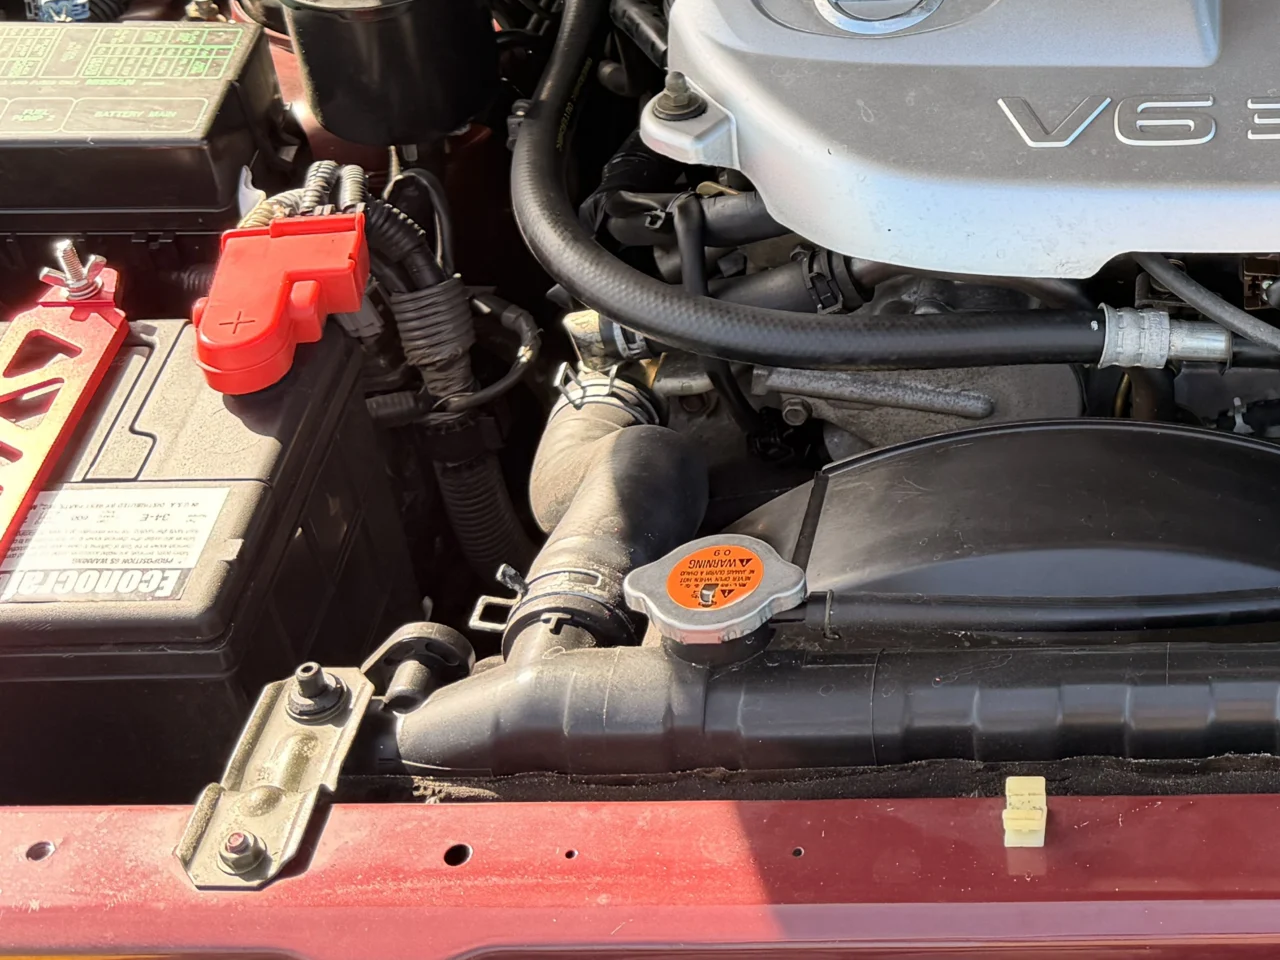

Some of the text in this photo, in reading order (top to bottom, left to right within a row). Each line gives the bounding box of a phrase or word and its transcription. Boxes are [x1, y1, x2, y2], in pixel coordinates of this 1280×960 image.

[22, 108, 50, 116] FUEL
[12, 114, 44, 122] PUMP
[997, 93, 1216, 147] V6
[140, 513, 171, 522] 34-E
[121, 557, 174, 565] PROPOSITION
[688, 558, 737, 569] WARNING
